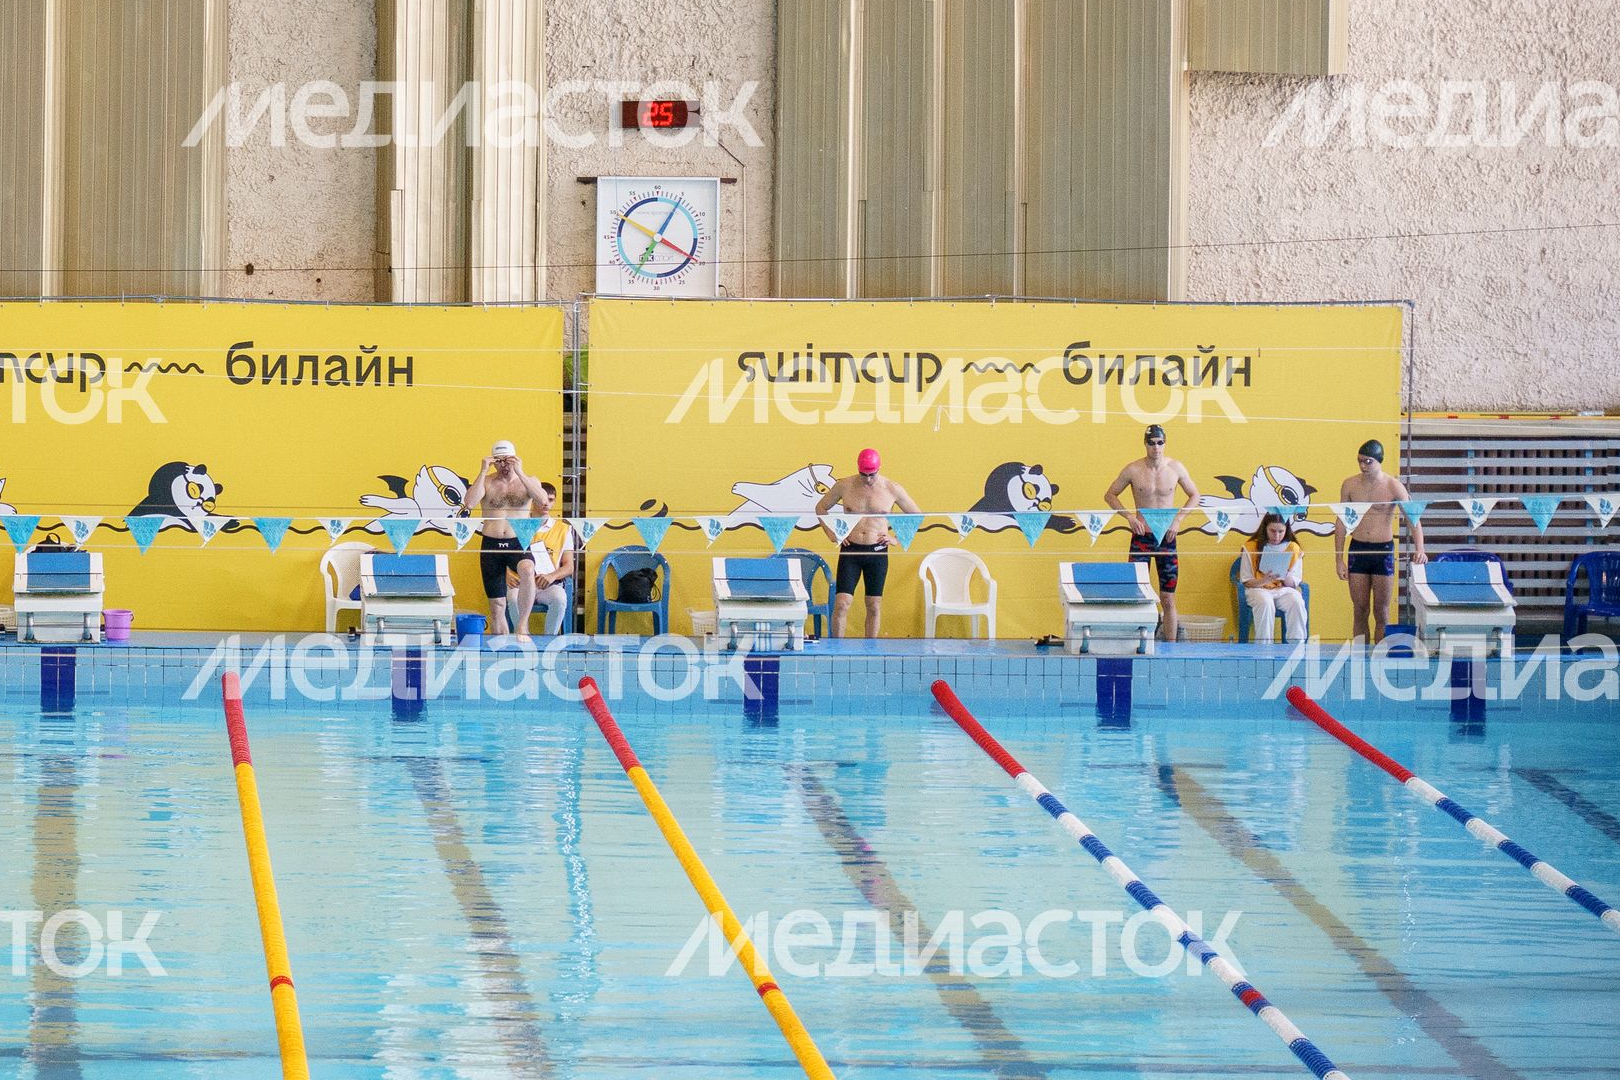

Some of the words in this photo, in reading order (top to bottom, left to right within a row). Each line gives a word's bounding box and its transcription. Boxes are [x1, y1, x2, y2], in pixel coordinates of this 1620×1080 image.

[641, 102, 673, 127] 25
[225, 341, 414, 387] билайн
[737, 343, 942, 393] swimcup
[1062, 341, 1251, 387] билайн
